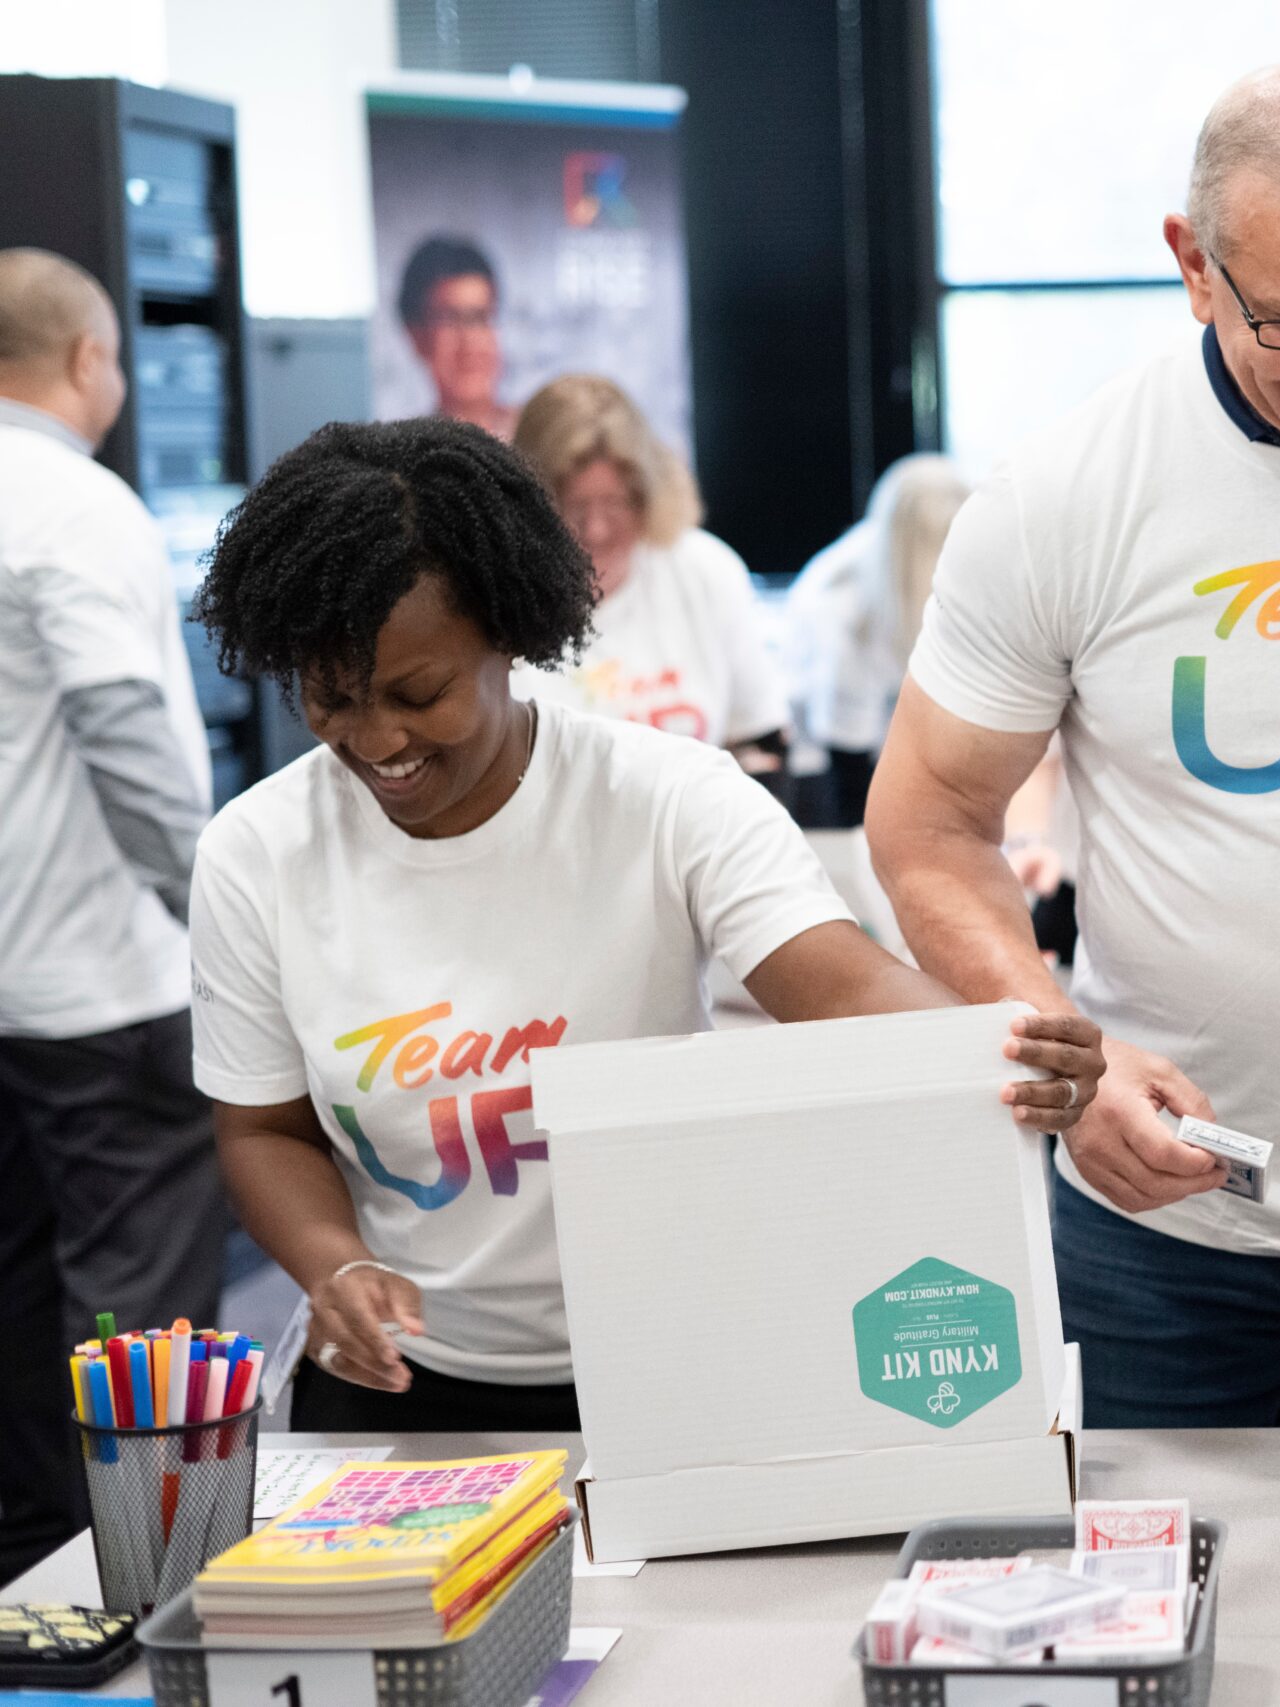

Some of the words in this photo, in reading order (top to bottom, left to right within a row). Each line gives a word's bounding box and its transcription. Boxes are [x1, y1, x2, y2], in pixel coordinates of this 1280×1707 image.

[333, 1000, 568, 1093] Team
[893, 1329, 939, 1343] Gratitude
[941, 1325, 979, 1339] Military
[881, 1351, 921, 1381] KIT
[929, 1343, 999, 1376] KYND
